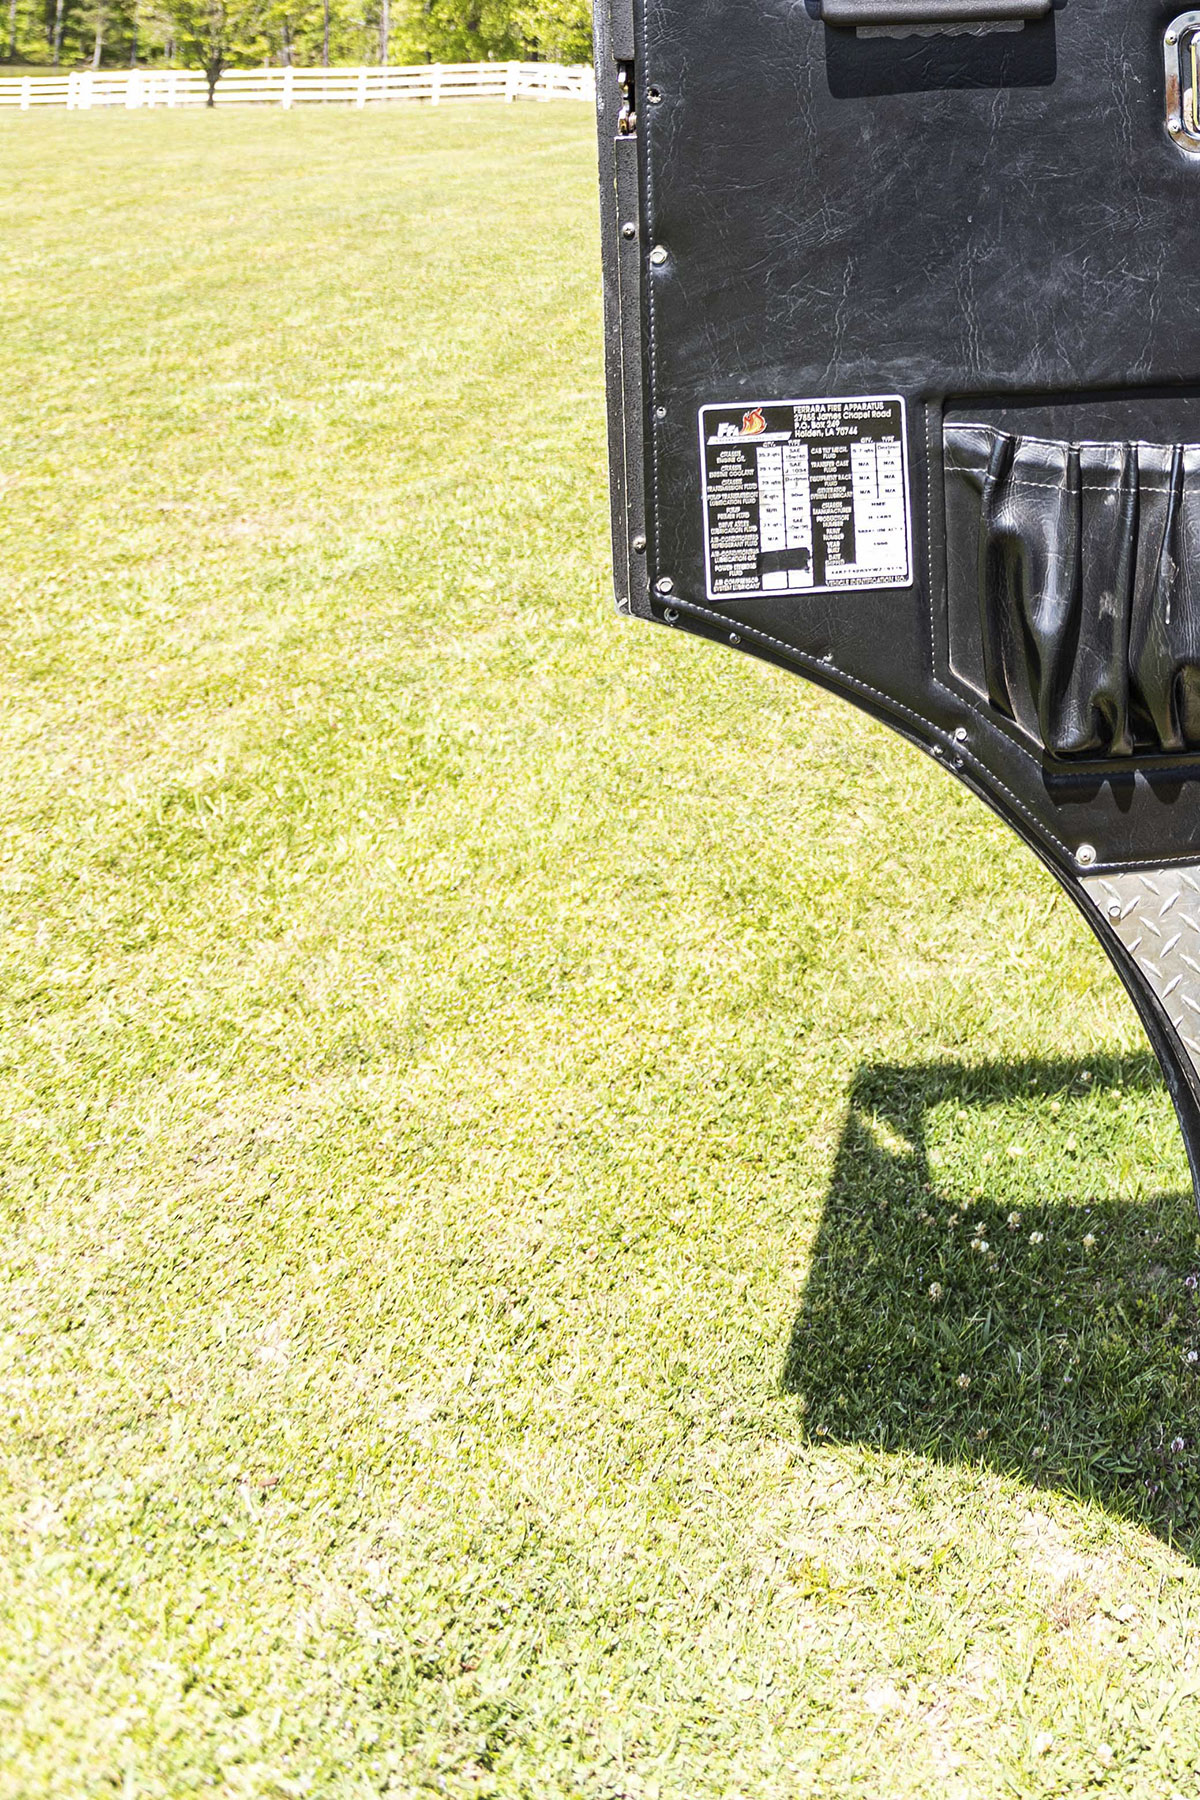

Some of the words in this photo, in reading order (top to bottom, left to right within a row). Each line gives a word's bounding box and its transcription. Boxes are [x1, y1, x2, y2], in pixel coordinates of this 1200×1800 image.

[794, 404, 826, 414] FERRARA
[827, 404, 842, 412] FIRE
[844, 402, 884, 411] APPARATUS
[816, 412, 842, 421] James
[842, 410, 871, 420] Chapel
[872, 408, 892, 418] Road
[794, 422, 810, 430] P.O.
[811, 421, 826, 429] Box
[826, 420, 840, 428] 249
[795, 429, 824, 438] Holden,
[825, 428, 835, 437] LA
